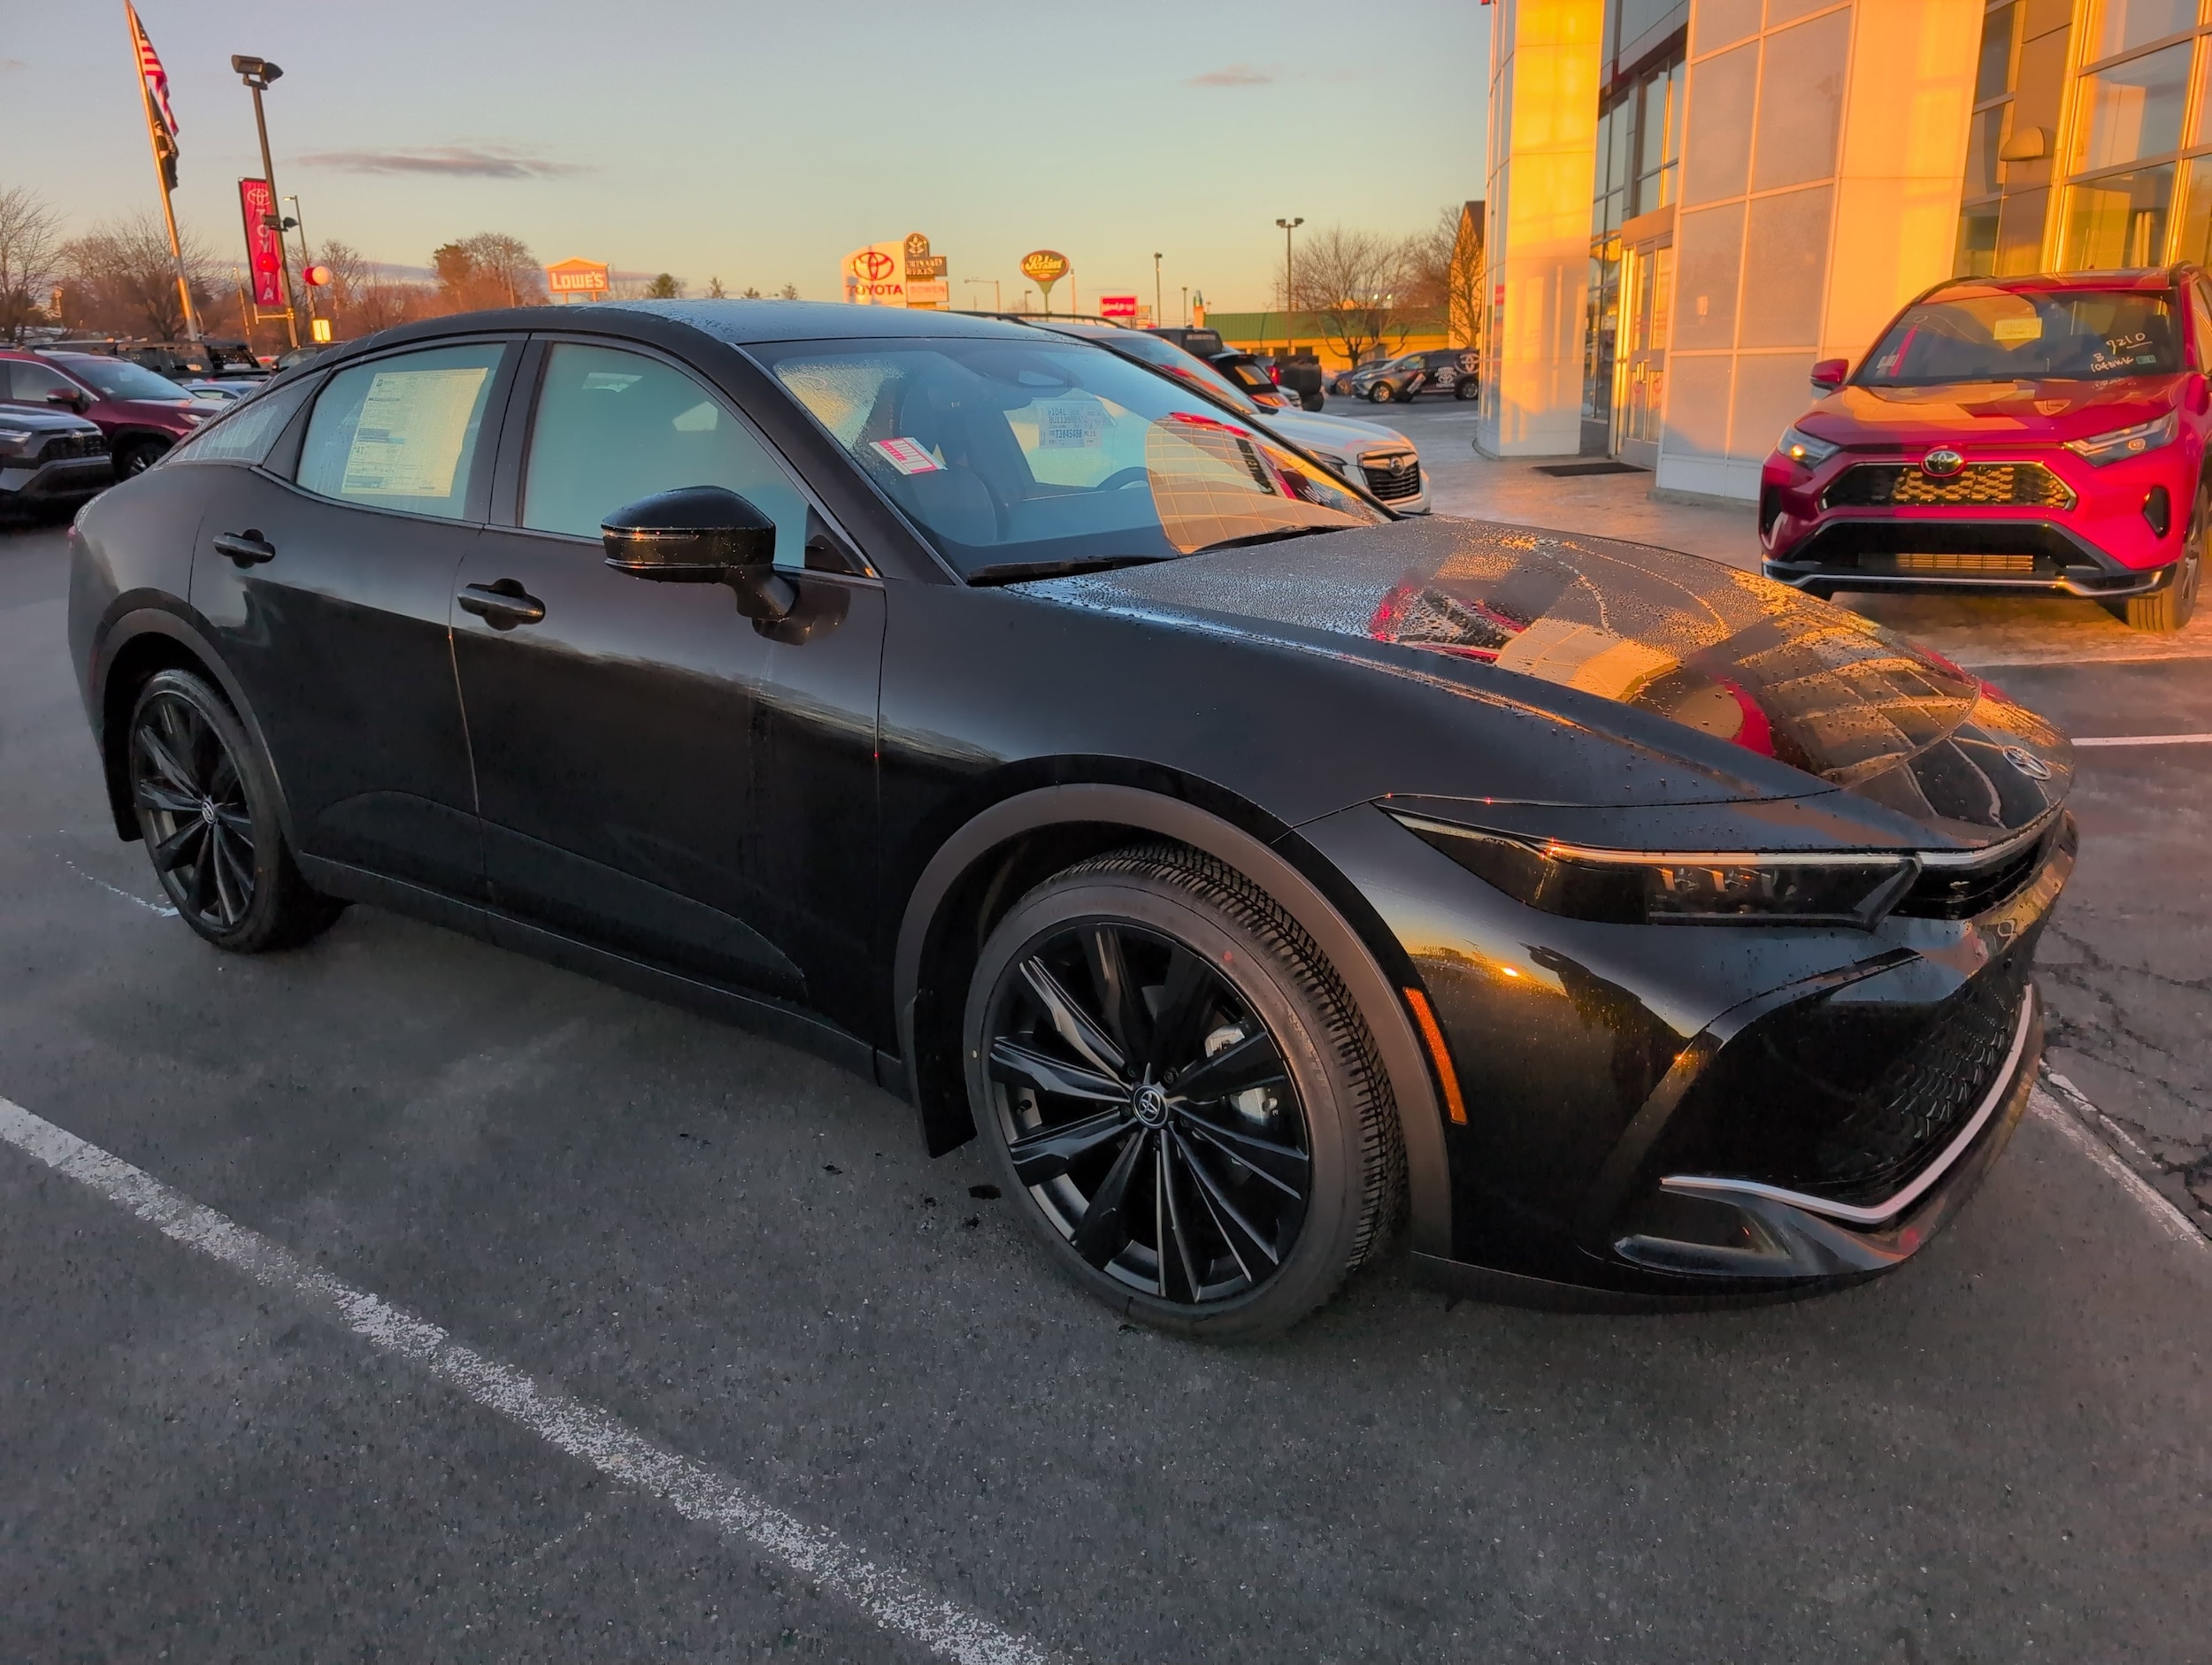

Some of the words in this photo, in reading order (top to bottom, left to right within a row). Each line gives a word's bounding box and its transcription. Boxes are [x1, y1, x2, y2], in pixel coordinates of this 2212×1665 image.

[256, 208, 274, 301] TOYTA
[550, 271, 605, 290] LOWE'S
[846, 284, 903, 296] TOYOTA
